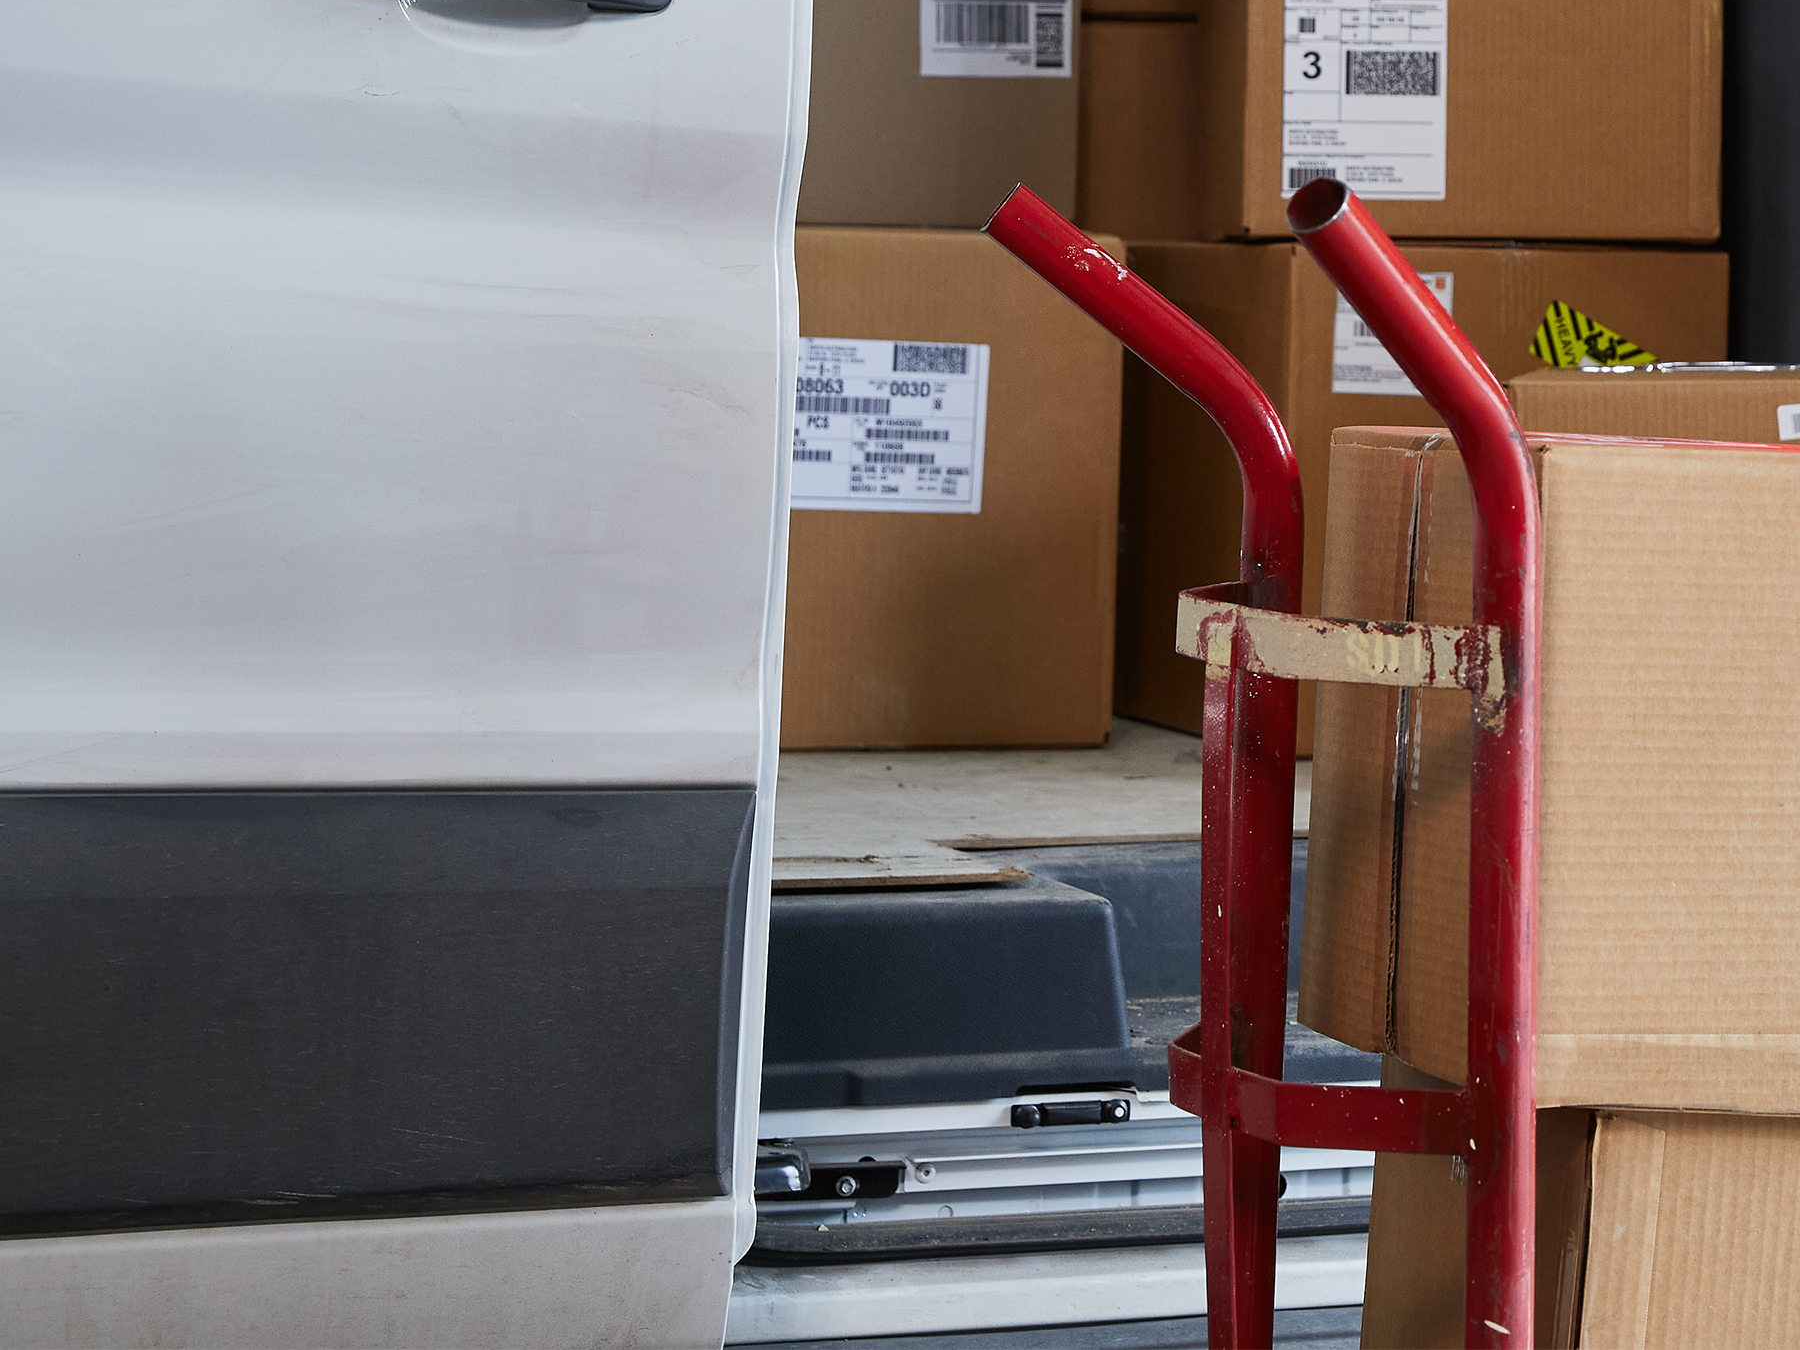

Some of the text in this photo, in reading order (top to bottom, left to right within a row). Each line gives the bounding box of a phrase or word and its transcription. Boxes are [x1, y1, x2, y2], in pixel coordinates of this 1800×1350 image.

[1303, 51, 1322, 79] 3
[890, 379, 931, 397] 003D
[807, 415, 830, 430] PCS
